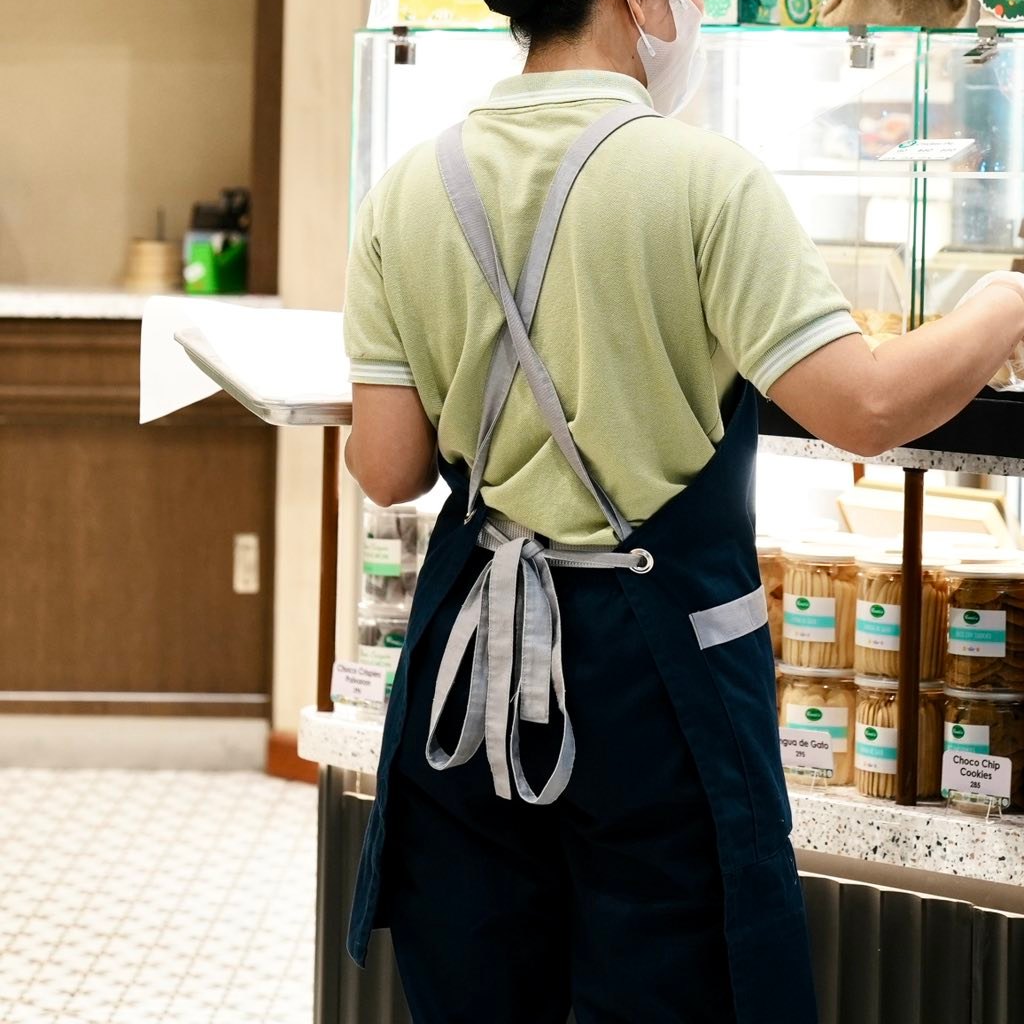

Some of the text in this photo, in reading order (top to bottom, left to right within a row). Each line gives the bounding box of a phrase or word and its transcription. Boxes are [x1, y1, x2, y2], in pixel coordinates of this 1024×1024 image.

[779, 738, 830, 750] ngua de Gato
[953, 755, 1001, 771] Choco Chip
[960, 767, 993, 780] Cookies
[970, 781, 981, 789] 285
